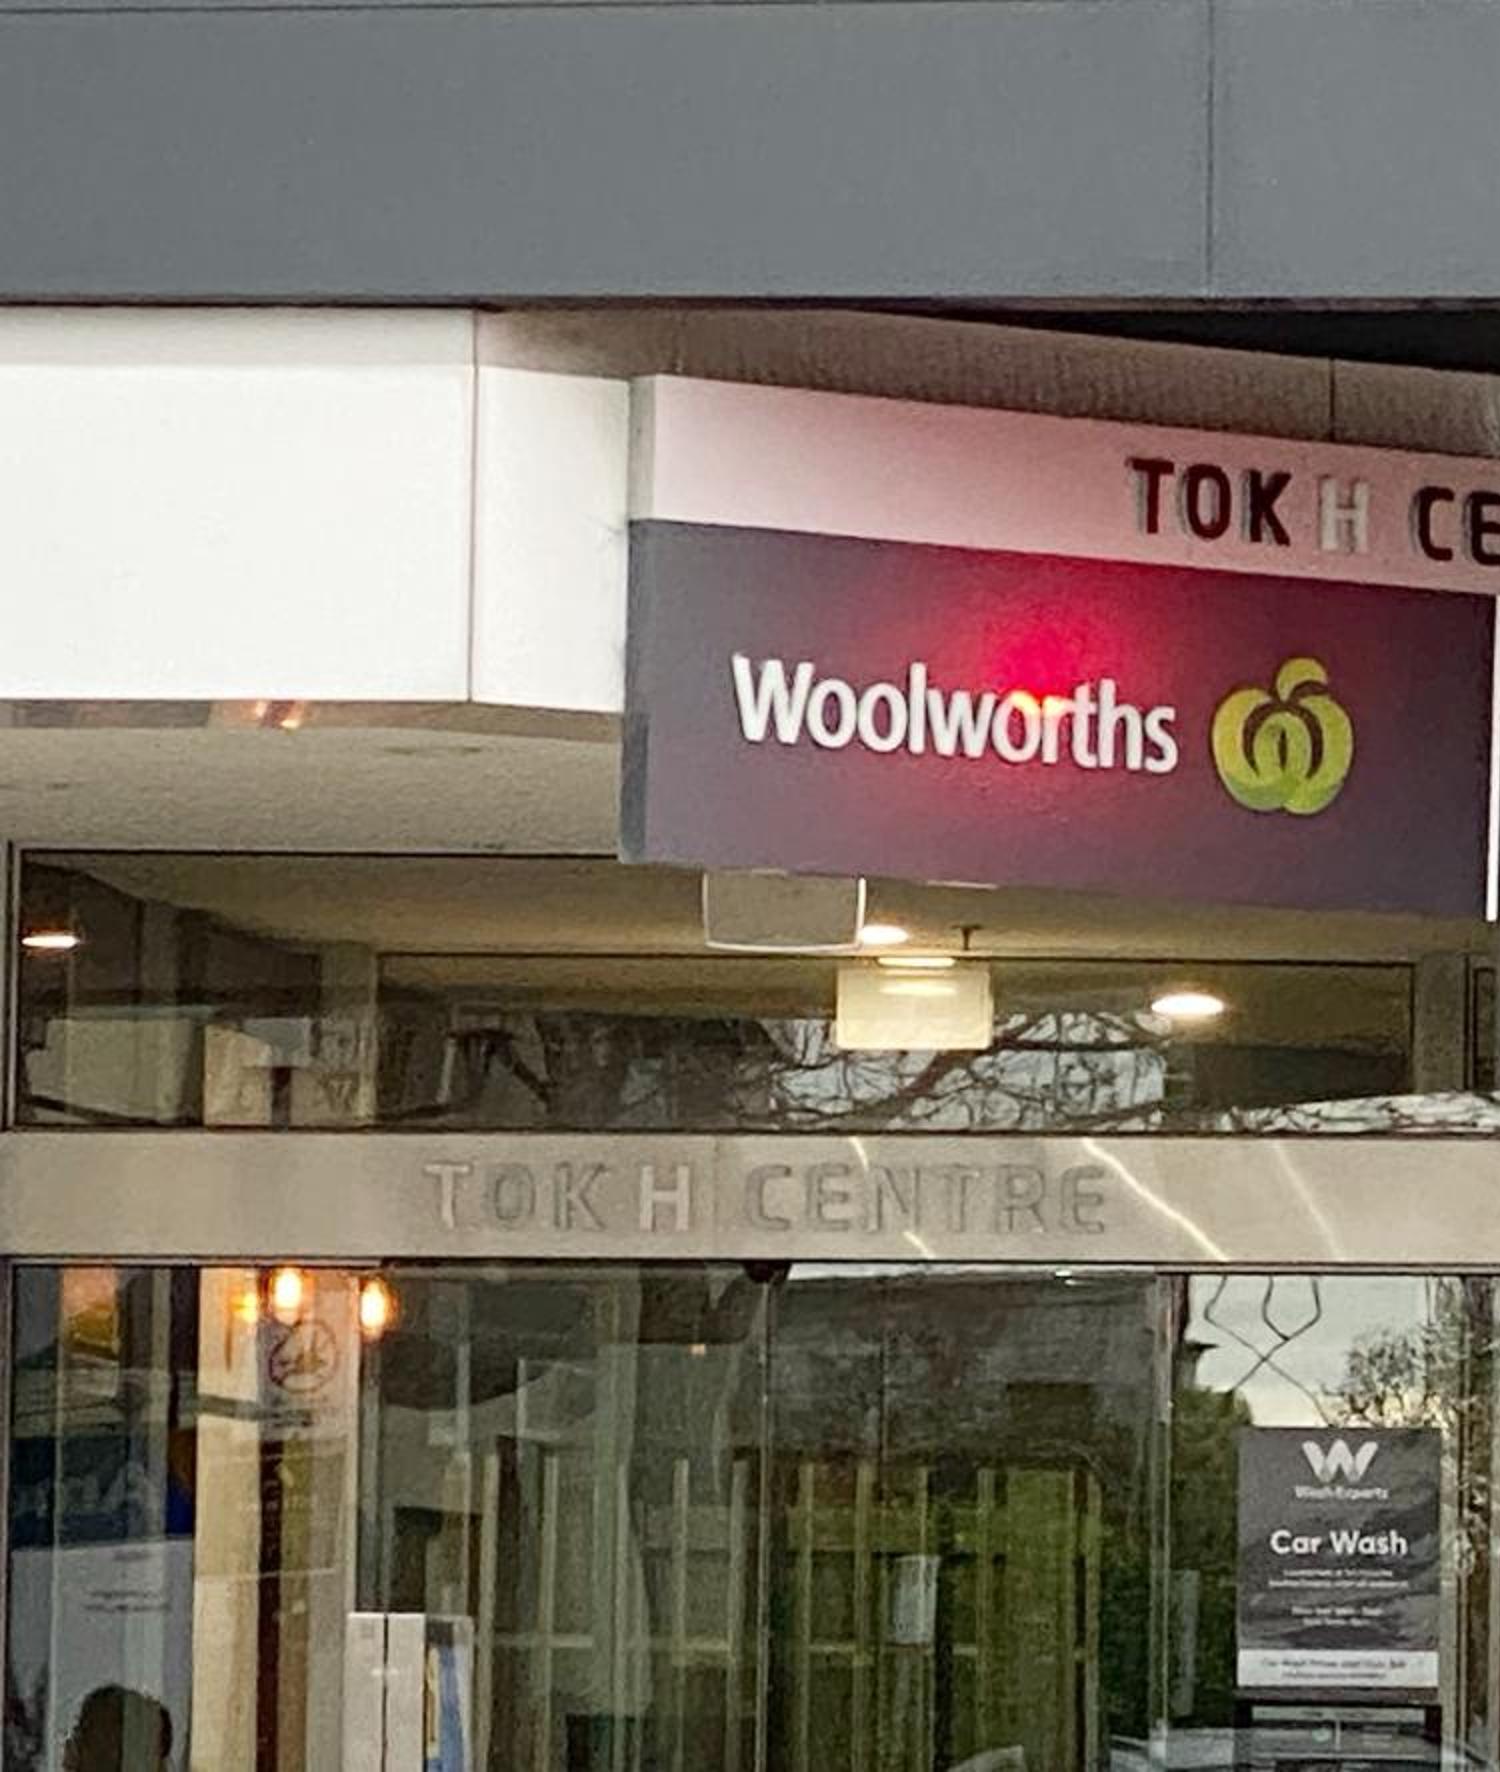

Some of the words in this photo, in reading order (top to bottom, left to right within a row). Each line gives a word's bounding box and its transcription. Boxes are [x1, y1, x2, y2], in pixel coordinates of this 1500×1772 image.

[1127, 456, 1291, 547] TOK
[1319, 474, 1371, 556] H
[731, 652, 1180, 774] Woolworths
[422, 1161, 609, 1232] TOK
[637, 1163, 698, 1232] H
[743, 1162, 1110, 1235] CENTRE
[1269, 1528, 1323, 1555] Car
[1328, 1528, 1409, 1556] Wash
